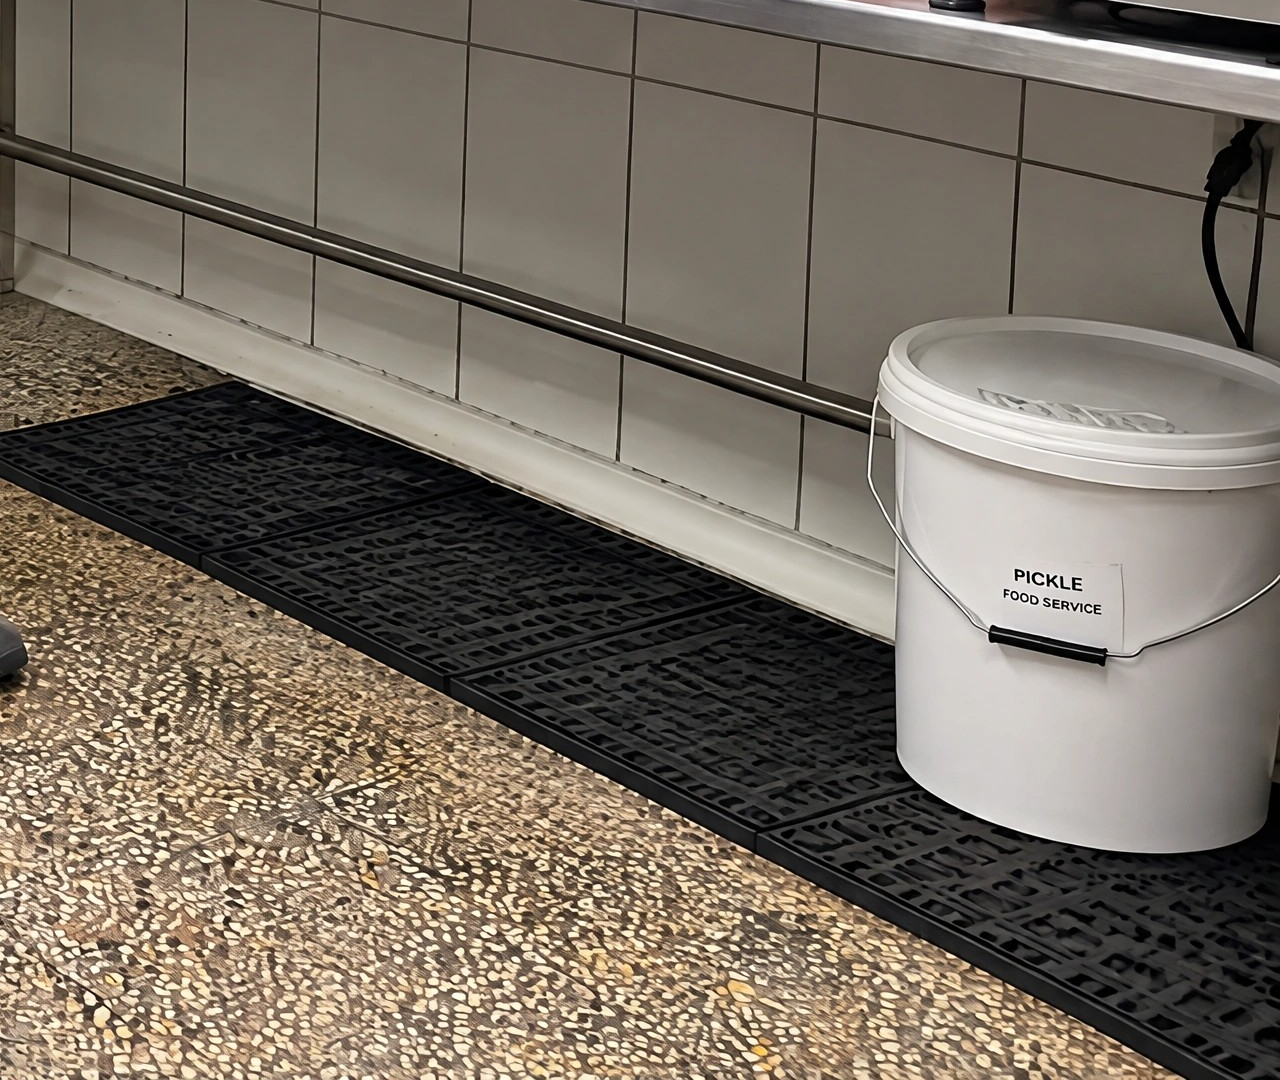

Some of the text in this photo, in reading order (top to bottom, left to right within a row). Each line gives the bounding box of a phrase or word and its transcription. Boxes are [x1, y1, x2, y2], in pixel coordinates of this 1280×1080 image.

[1014, 569, 1083, 591] PICKLE
[1004, 589, 1101, 615] FOOD SERVICE
